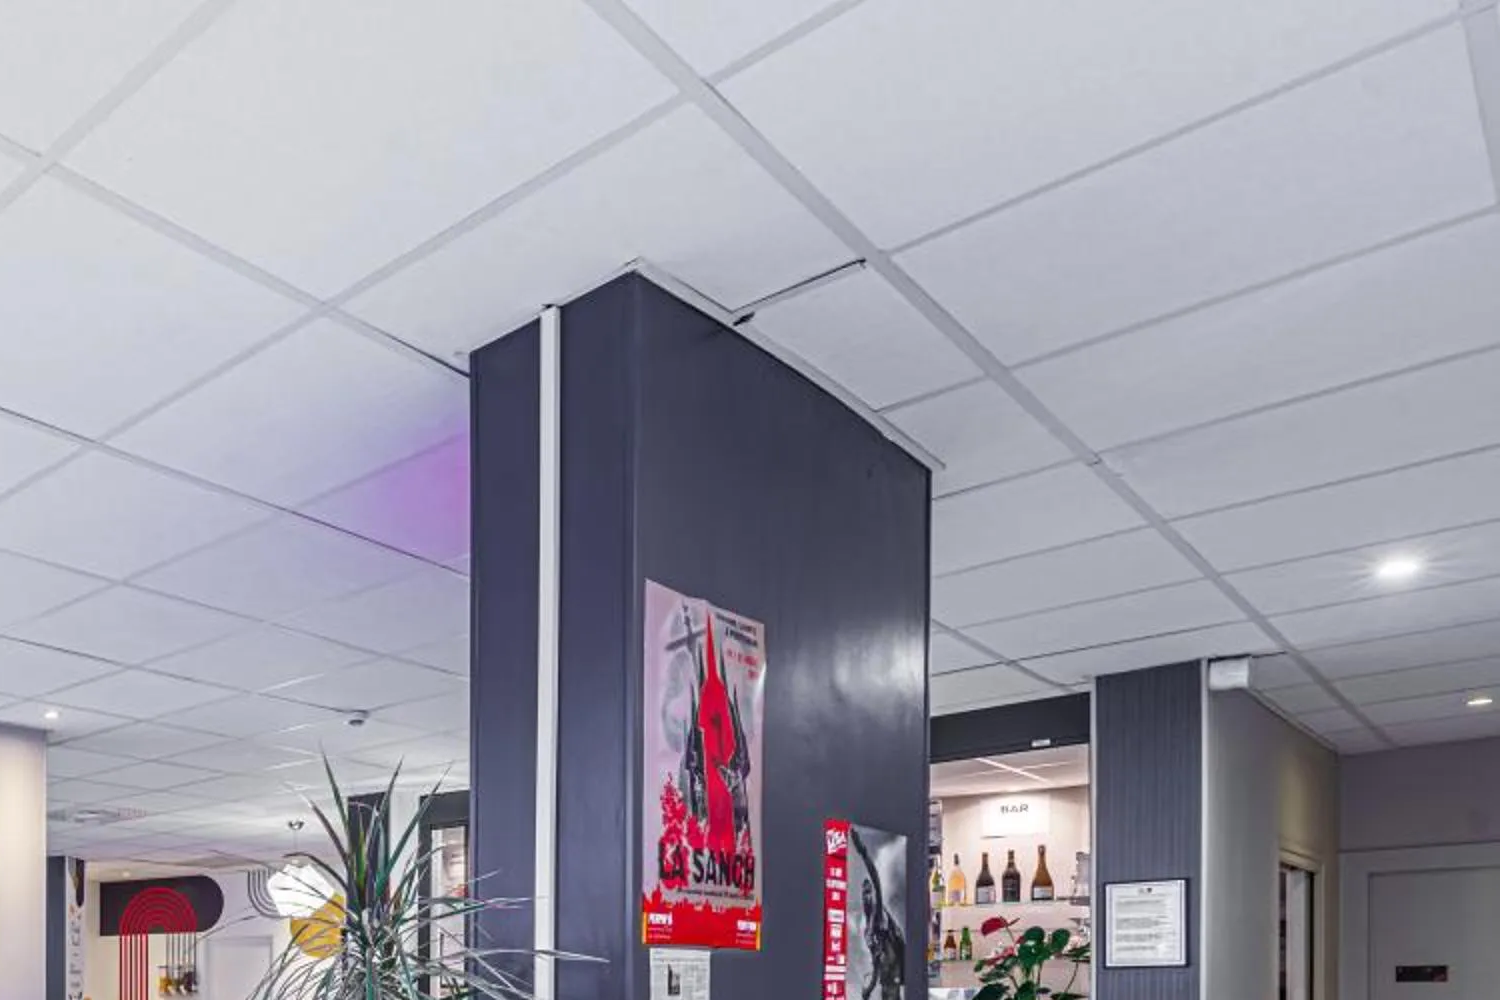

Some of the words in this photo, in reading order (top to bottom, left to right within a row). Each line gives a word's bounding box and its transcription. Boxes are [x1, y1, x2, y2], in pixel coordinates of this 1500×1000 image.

[1000, 803, 1029, 814] BAR
[658, 842, 685, 880] LA
[692, 848, 756, 890] SANCH
